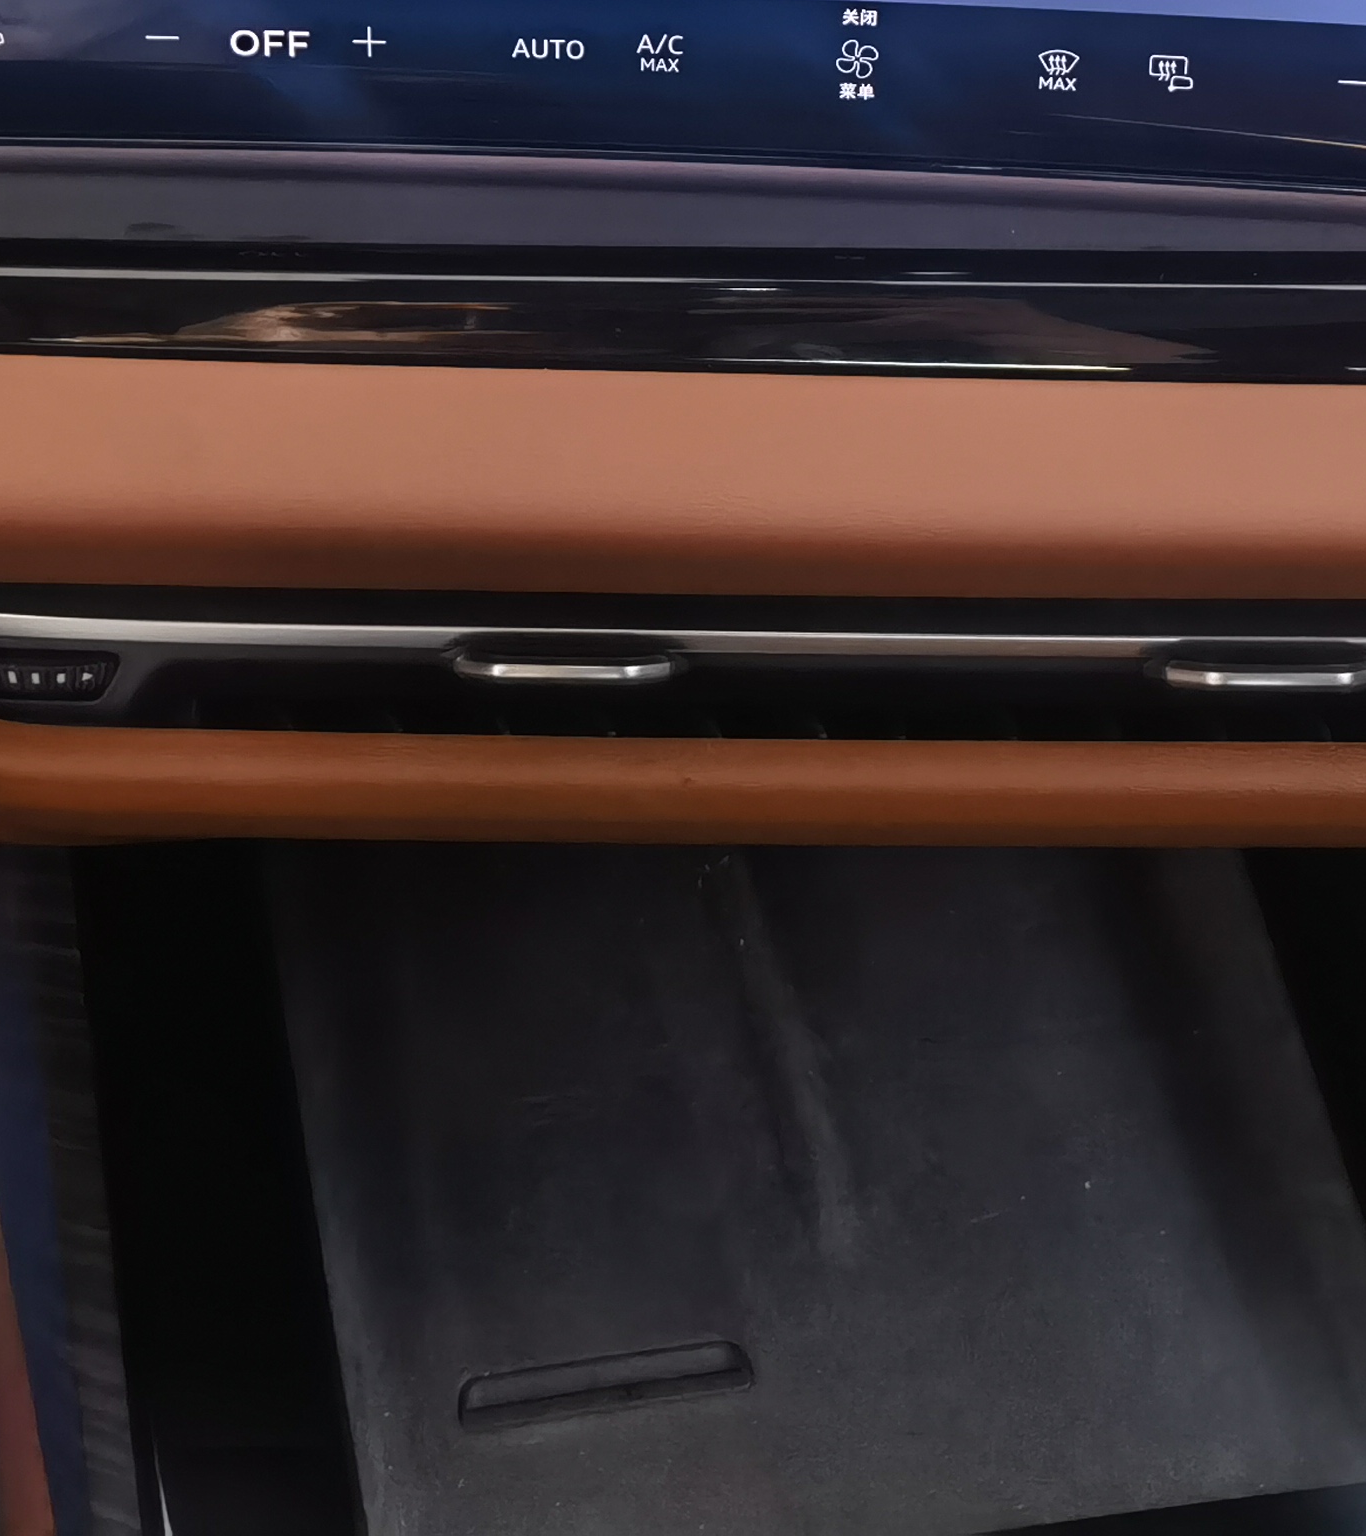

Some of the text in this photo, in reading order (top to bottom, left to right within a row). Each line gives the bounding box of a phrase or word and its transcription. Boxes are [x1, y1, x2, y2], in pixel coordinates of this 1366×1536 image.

[842, 8, 878, 27] 关闭
[229, 29, 310, 59] OFF
[511, 38, 586, 61] AUTO
[636, 33, 684, 55] A/C
[640, 57, 680, 73] MAX
[839, 82, 875, 101] 菜单
[1038, 76, 1077, 92] MAX
